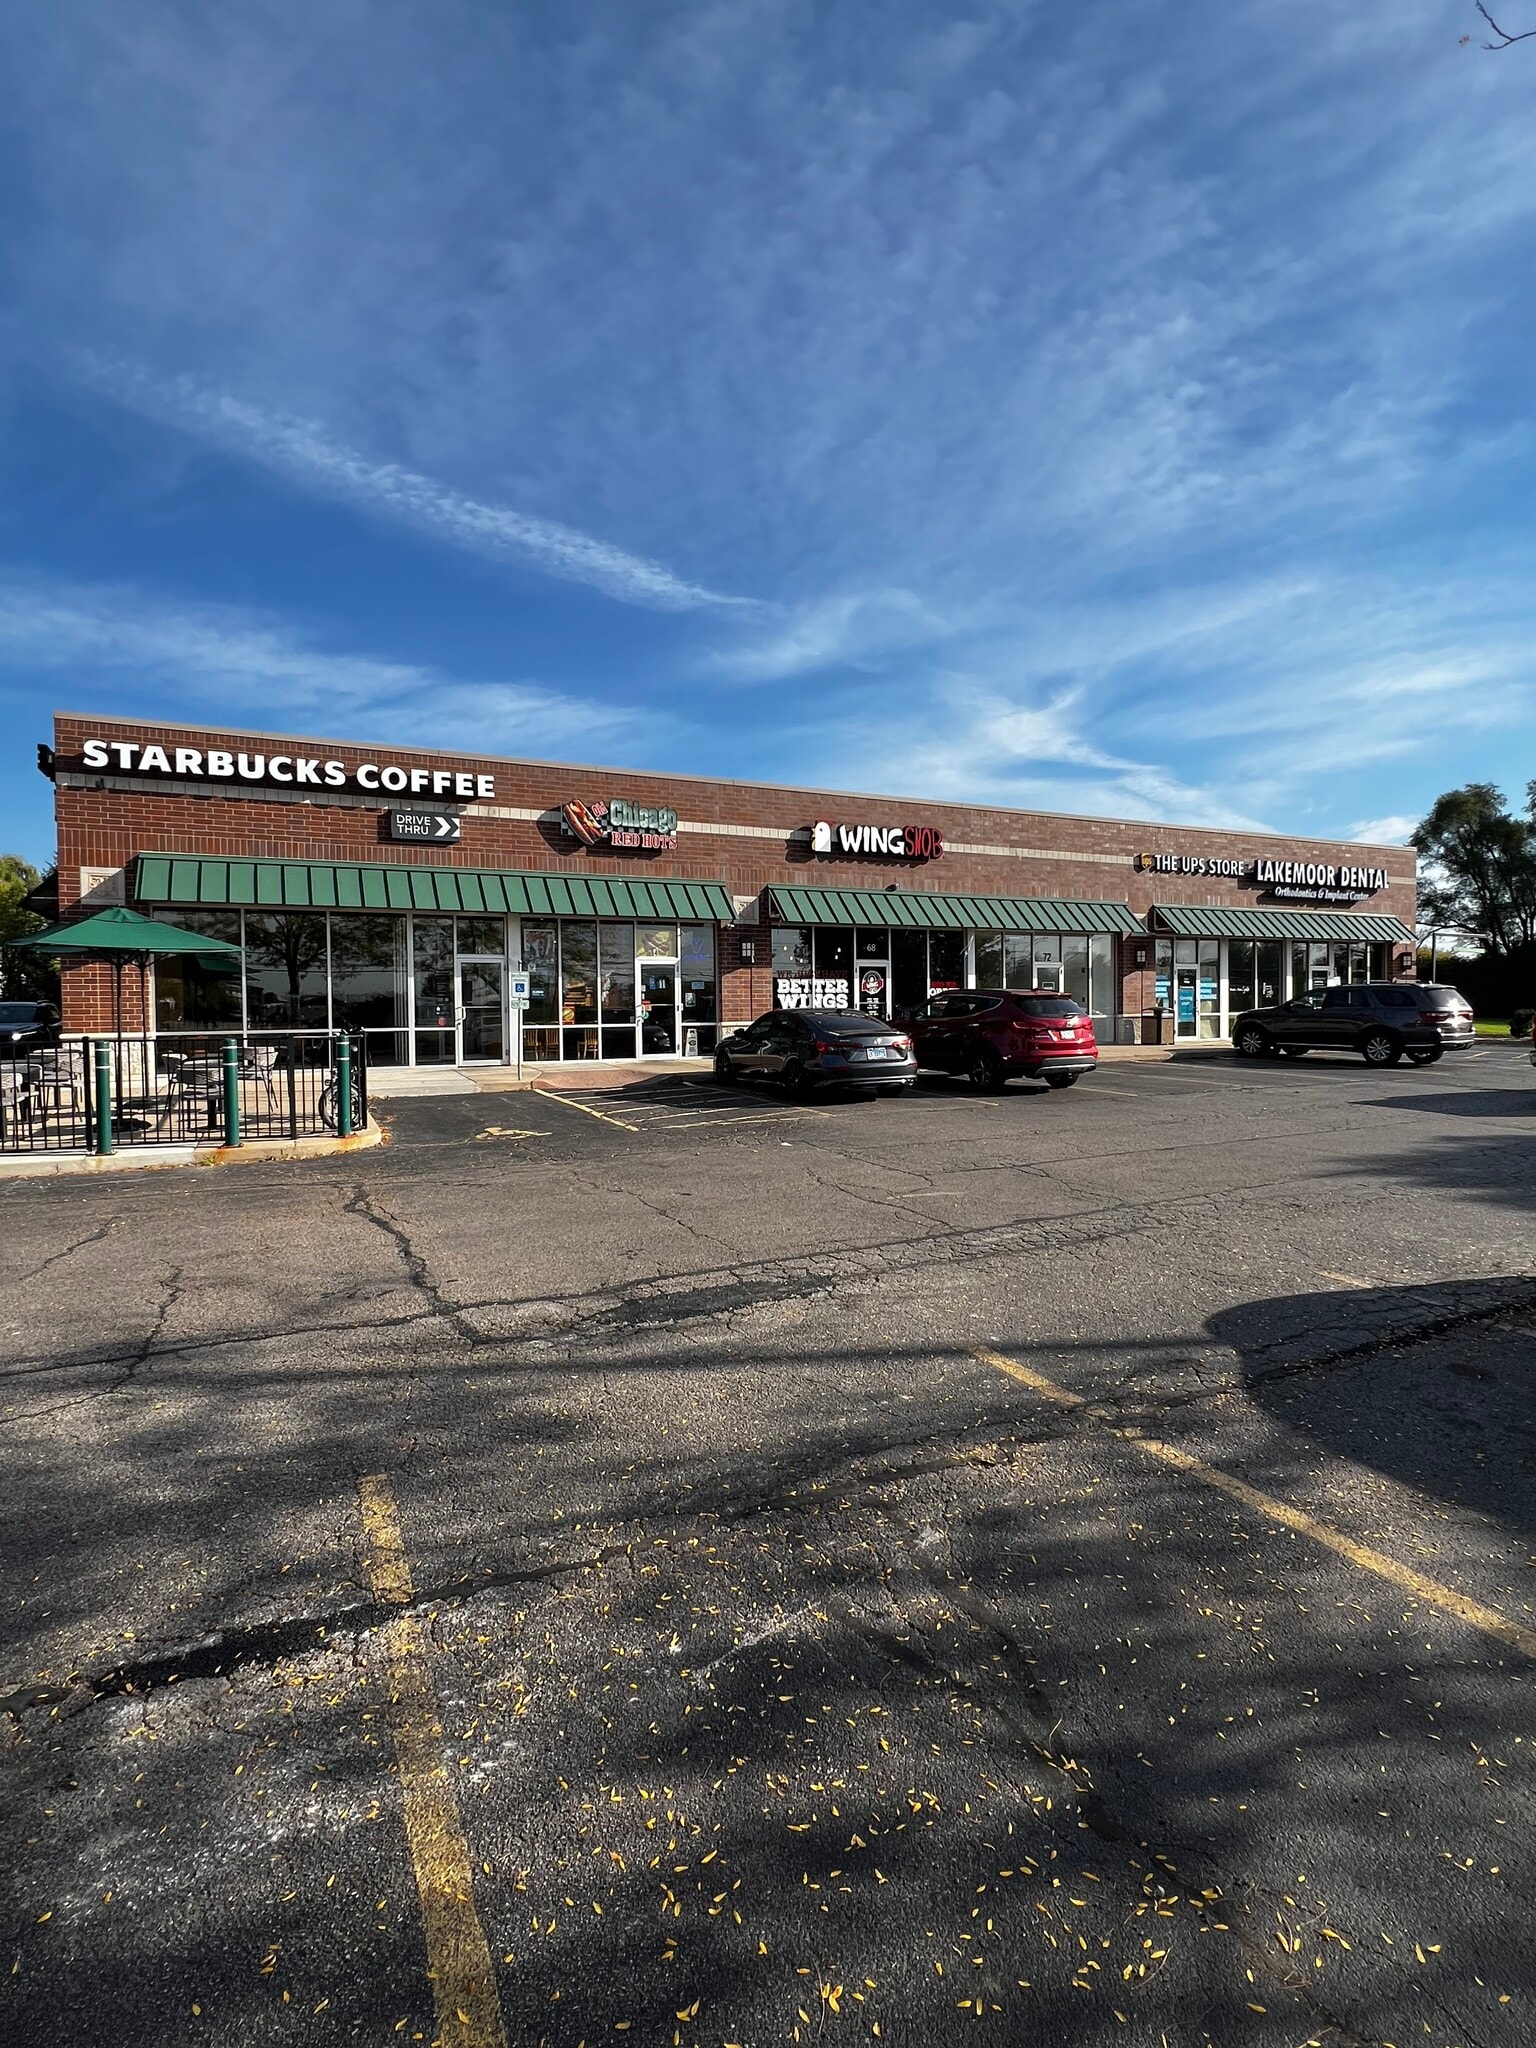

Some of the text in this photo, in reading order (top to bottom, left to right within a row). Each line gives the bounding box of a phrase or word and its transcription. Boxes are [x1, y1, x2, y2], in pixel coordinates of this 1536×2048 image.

[83, 739, 496, 798] STARBUCKS COFFEE
[396, 814, 431, 826] DRIVE
[610, 799, 677, 833] Chicago
[397, 825, 429, 835] THRU
[611, 832, 677, 849] RED HOTS
[1155, 855, 1244, 876] THE UPS STORE
[1257, 860, 1389, 889] LAKEMOOR DENTAL
[1275, 887, 1369, 902] Orthodontics & Implant Center
[866, 943, 876, 952] 68
[1042, 952, 1052, 962] 72
[822, 969, 848, 978] HAVE
[777, 978, 849, 994] BETTER
[777, 993, 849, 1009] WINGS
